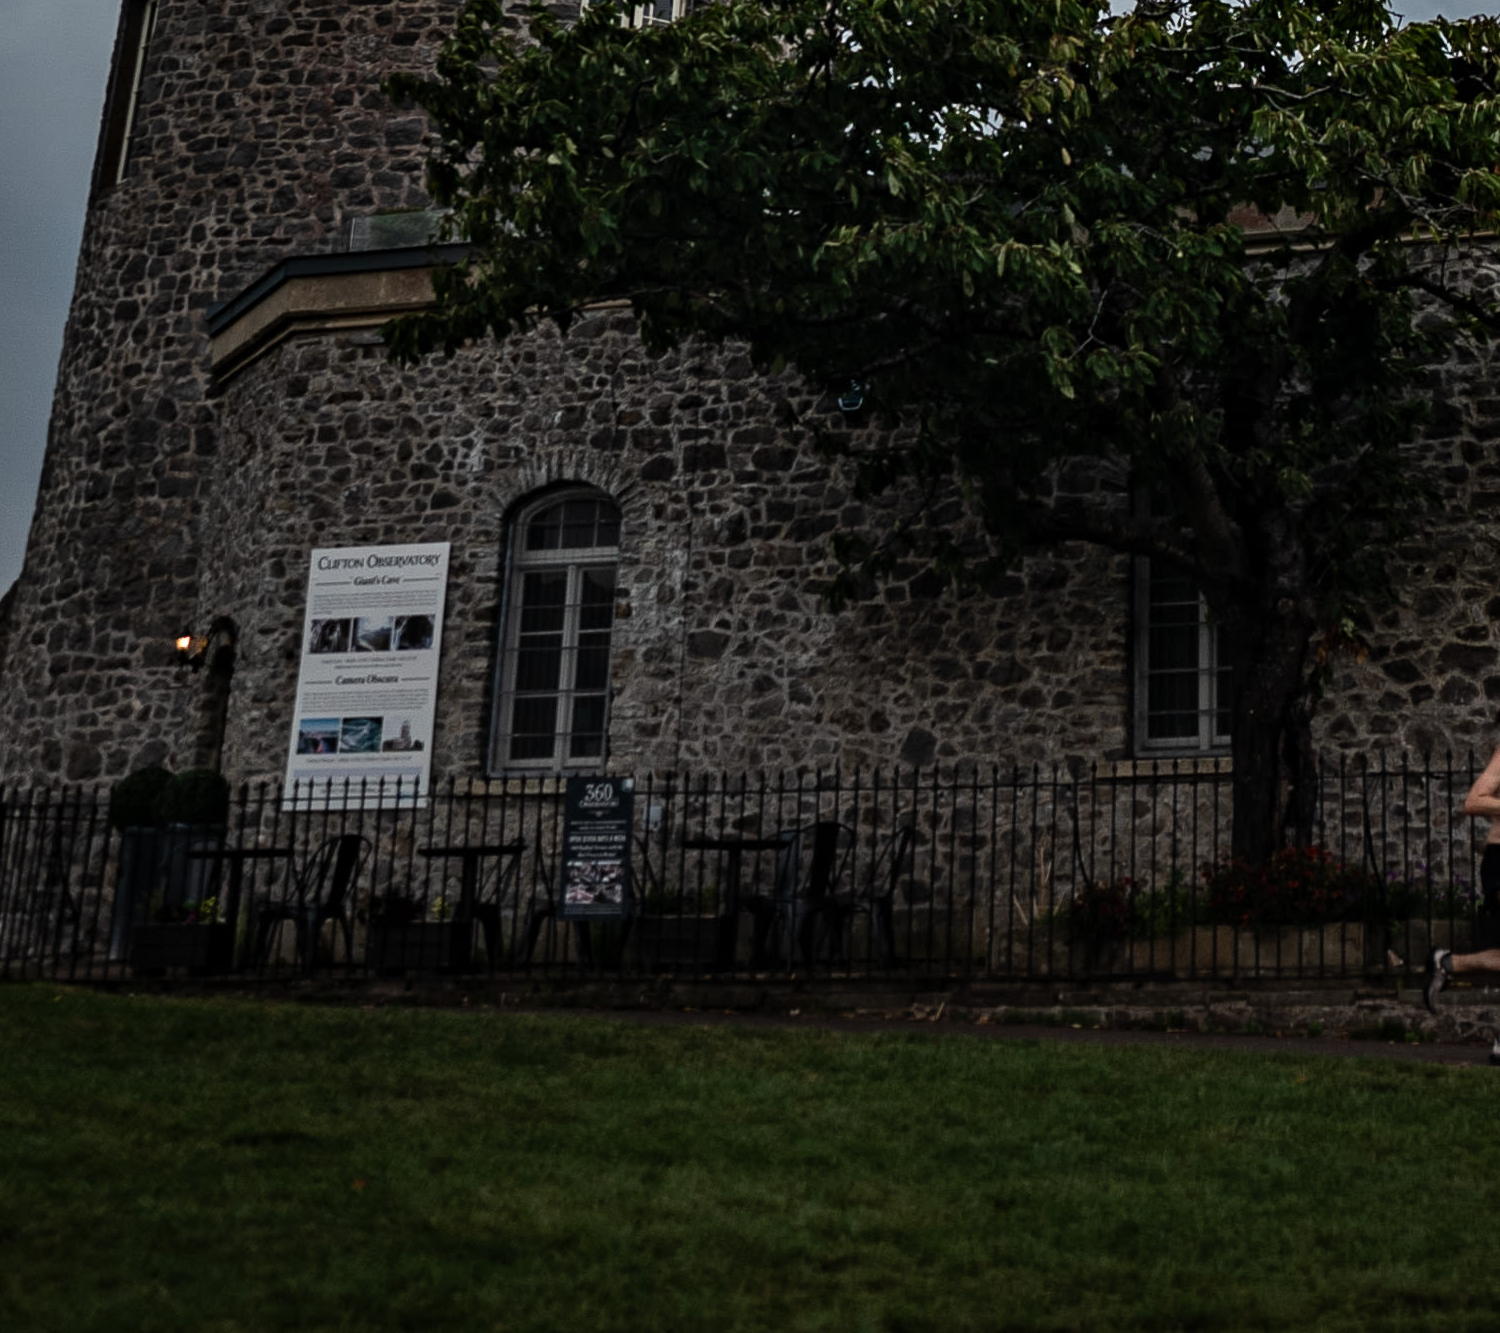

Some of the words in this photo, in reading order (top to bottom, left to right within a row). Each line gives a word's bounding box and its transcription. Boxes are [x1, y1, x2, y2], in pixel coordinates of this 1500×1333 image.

[318, 556, 364, 570] CLIFTON
[367, 553, 441, 568] OBSERVATORY
[584, 783, 614, 801] 360
